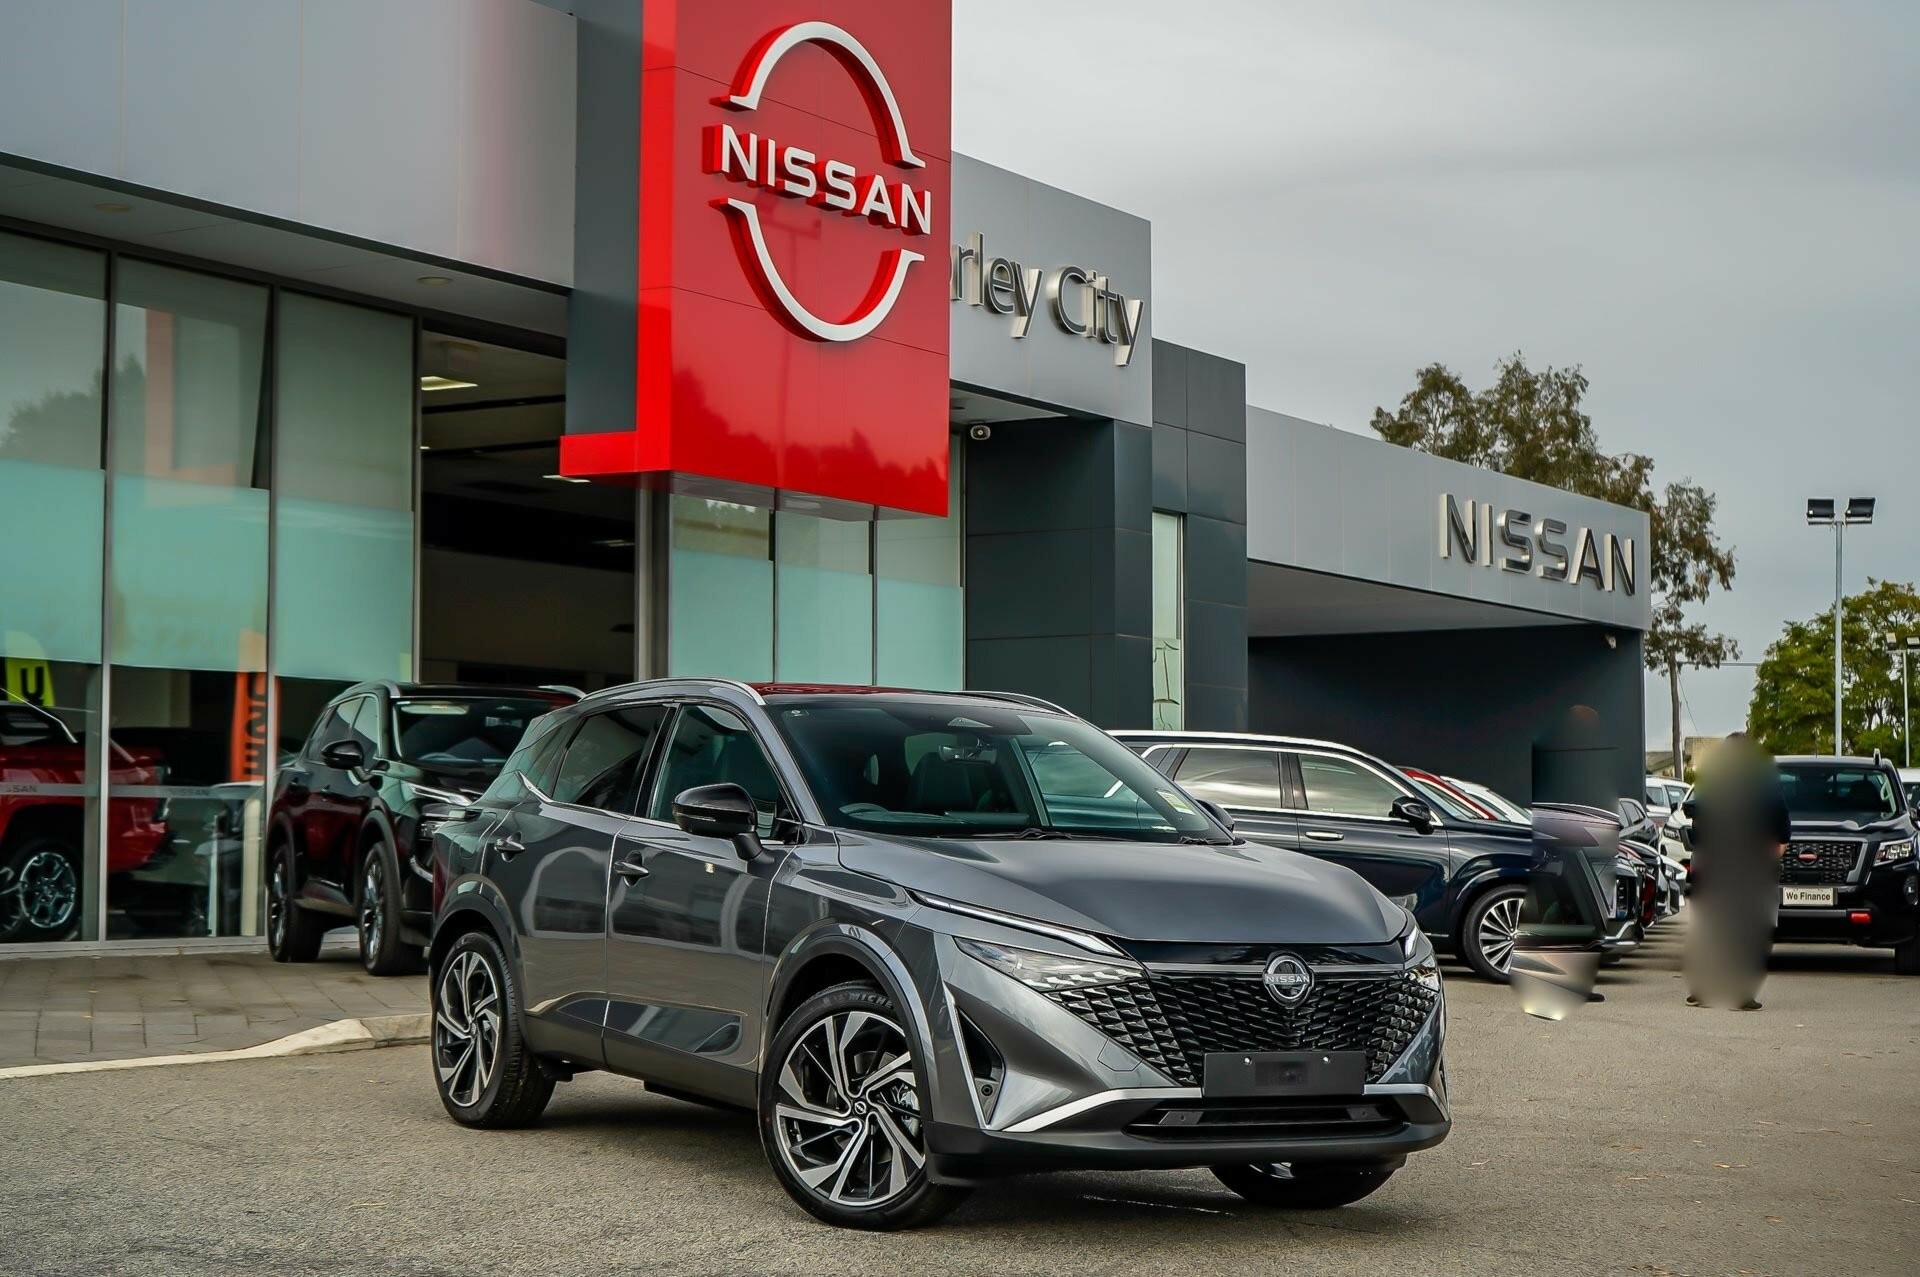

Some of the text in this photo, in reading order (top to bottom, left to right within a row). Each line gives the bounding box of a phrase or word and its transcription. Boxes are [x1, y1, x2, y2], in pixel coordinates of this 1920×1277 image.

[720, 124, 931, 235] NISSAN
[950, 232, 1144, 366] rley City
[1440, 494, 1635, 596] NISSAN
[1800, 892, 1831, 900] Finance
[850, 993, 893, 1008] MICHE
[1266, 975, 1310, 983] NISSAN
